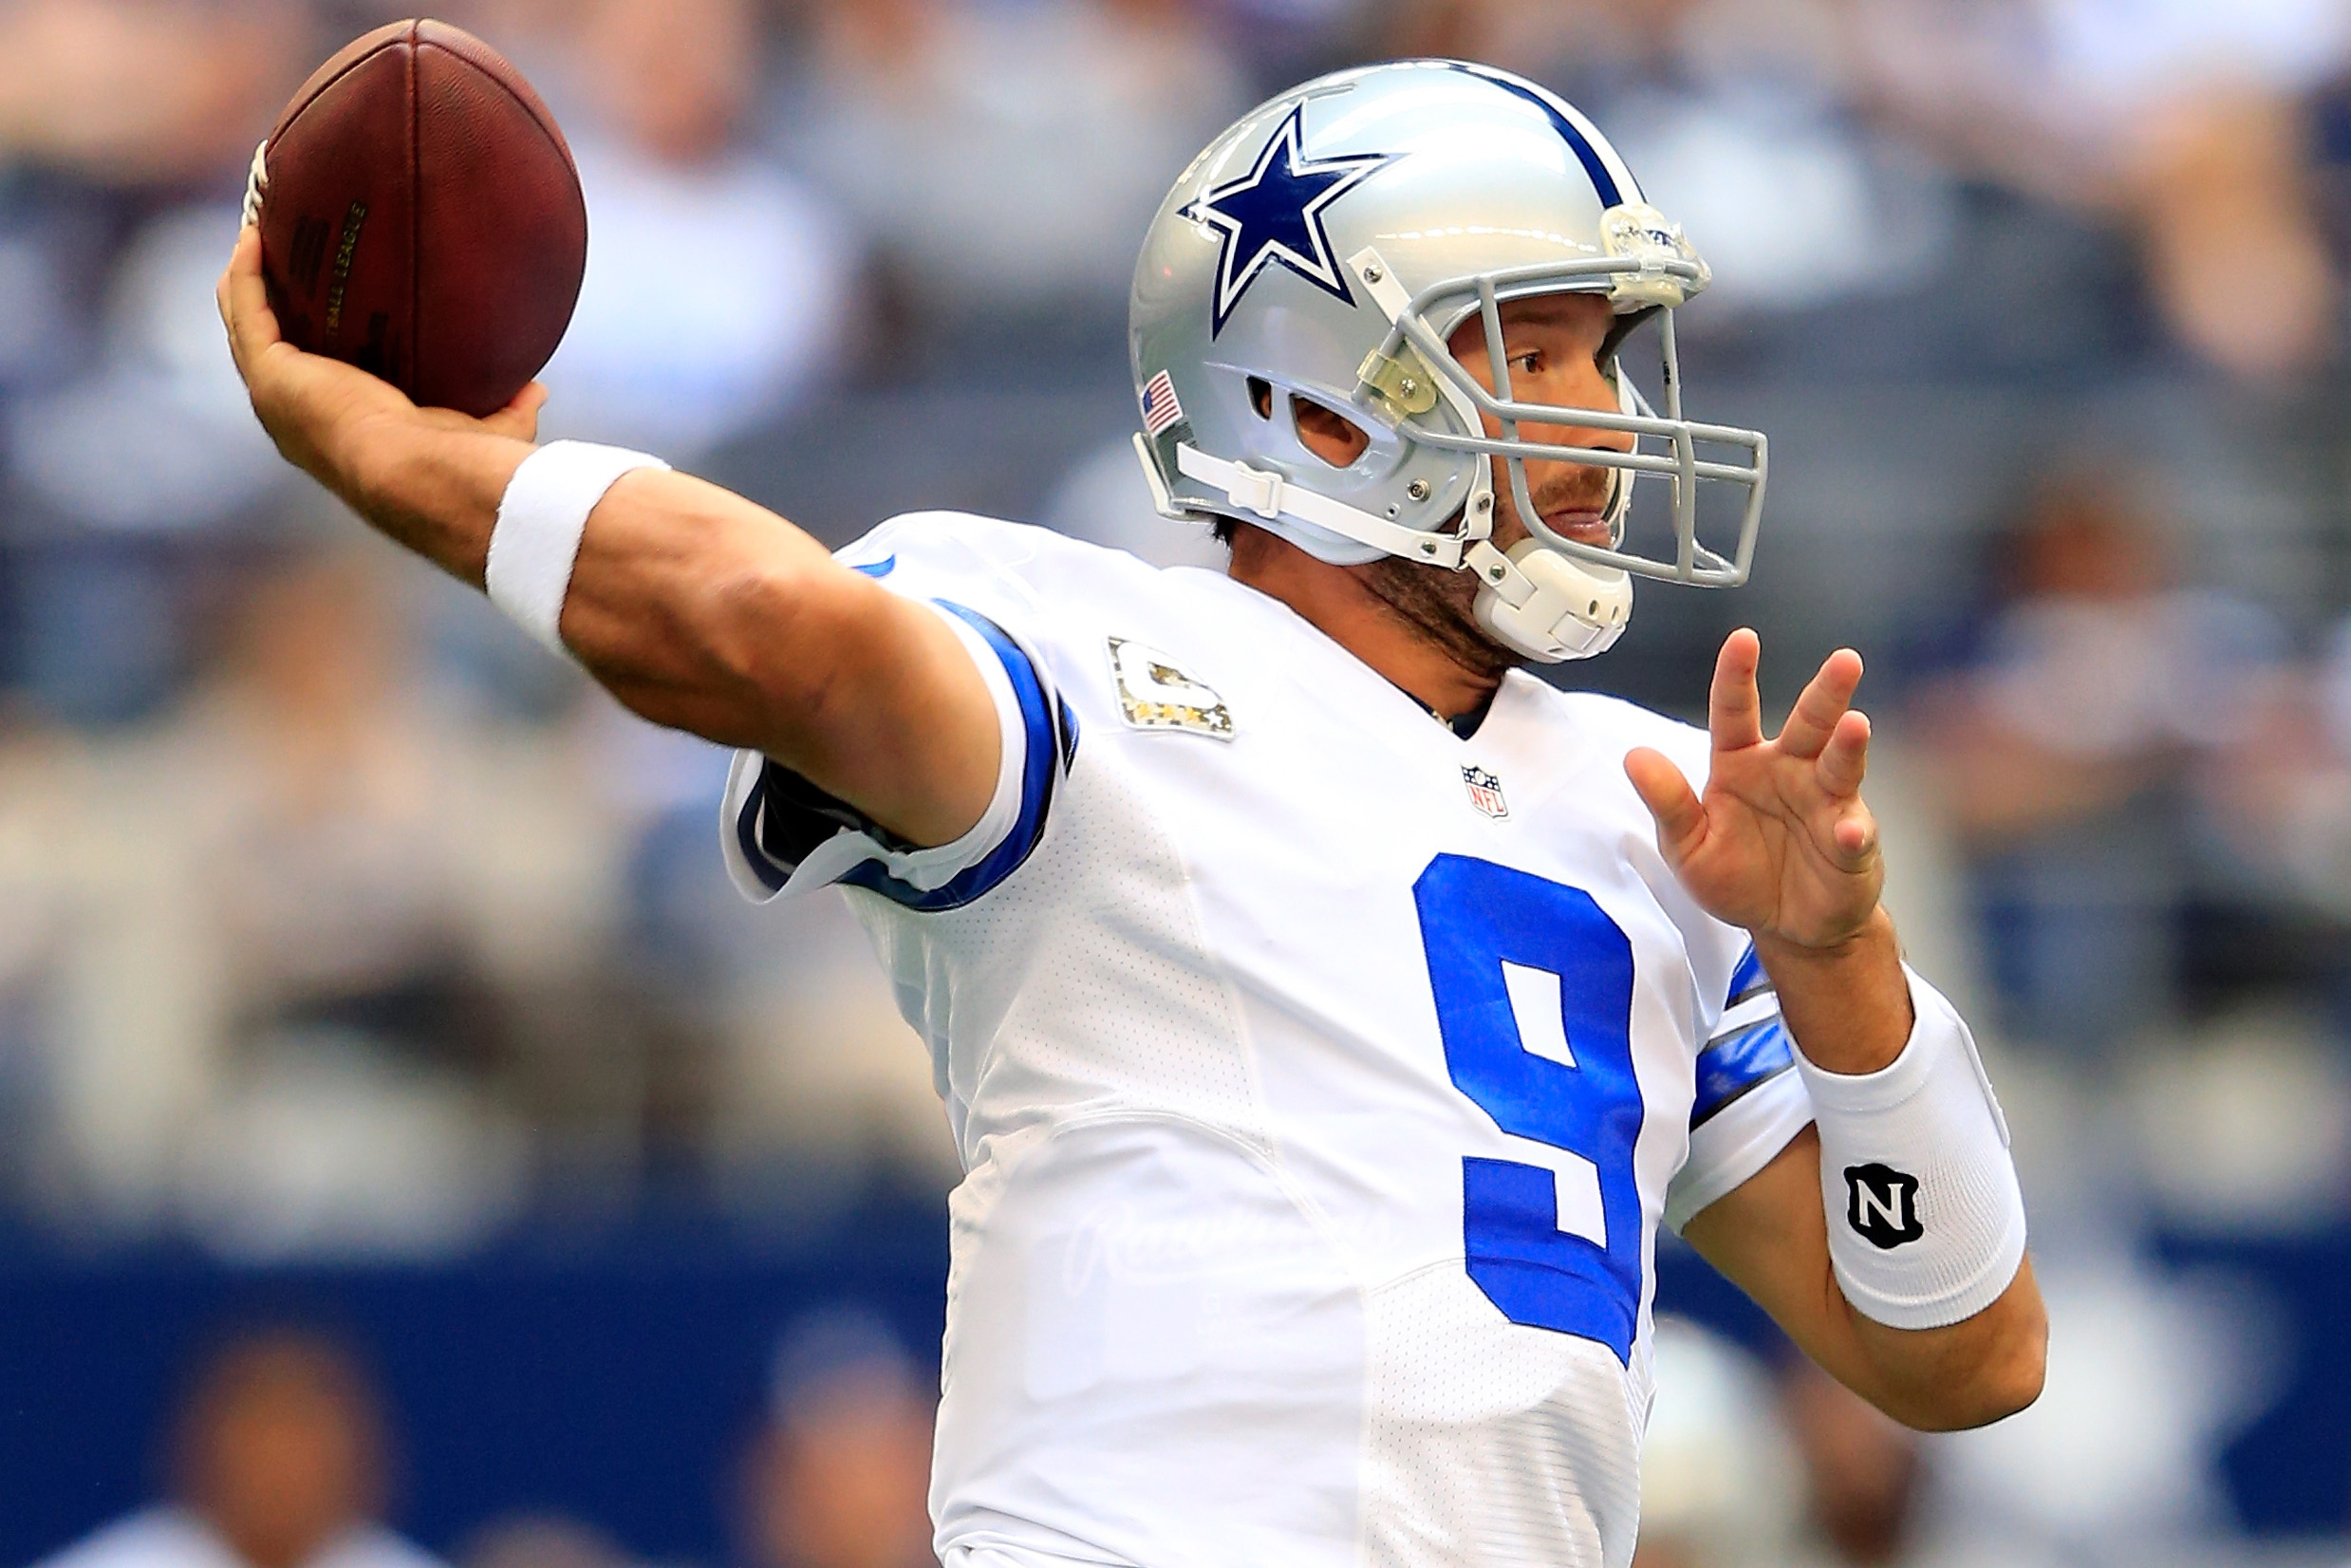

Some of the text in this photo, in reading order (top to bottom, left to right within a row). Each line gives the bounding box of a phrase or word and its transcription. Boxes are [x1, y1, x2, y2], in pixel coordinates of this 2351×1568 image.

[1469, 785, 1504, 813] NFL
[1411, 852, 1644, 1372] 9
[1856, 1179, 1906, 1231] N
